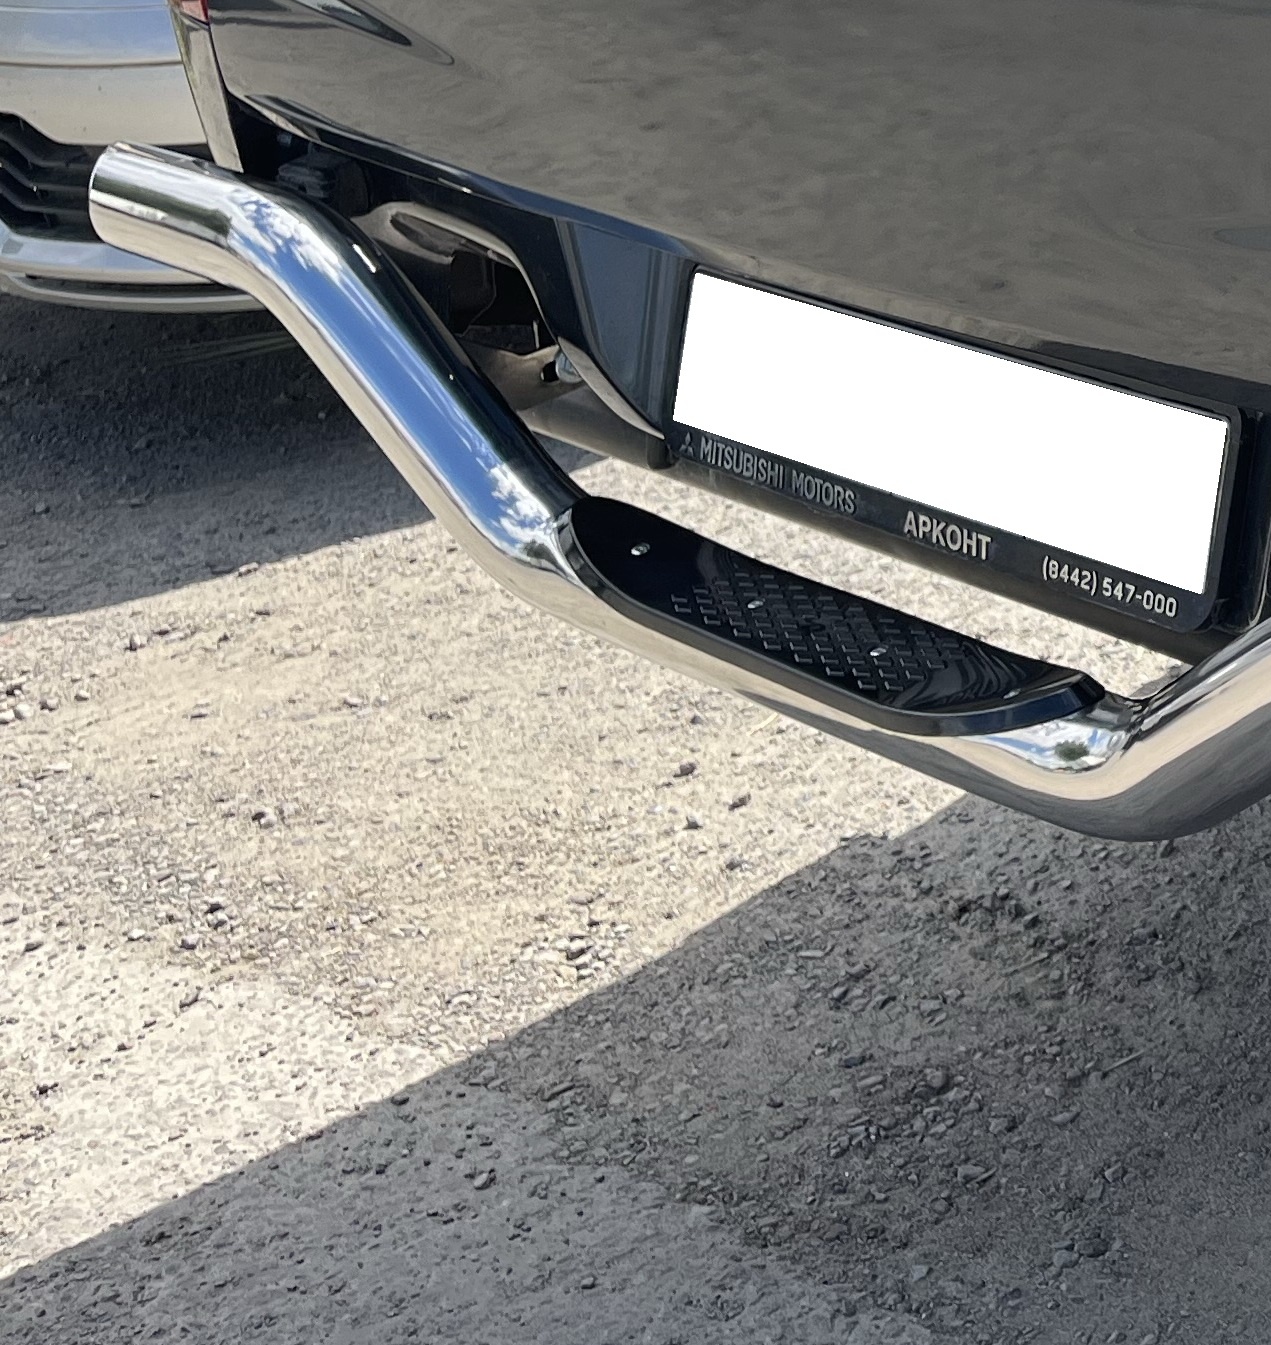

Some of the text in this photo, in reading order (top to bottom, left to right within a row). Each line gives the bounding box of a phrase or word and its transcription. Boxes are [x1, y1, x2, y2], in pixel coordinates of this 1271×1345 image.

[700, 437, 855, 514] MITSUBISHI MOTORS
[903, 510, 992, 561] АРКОНТ
[1042, 555, 1178, 618] (8442) 547-000
